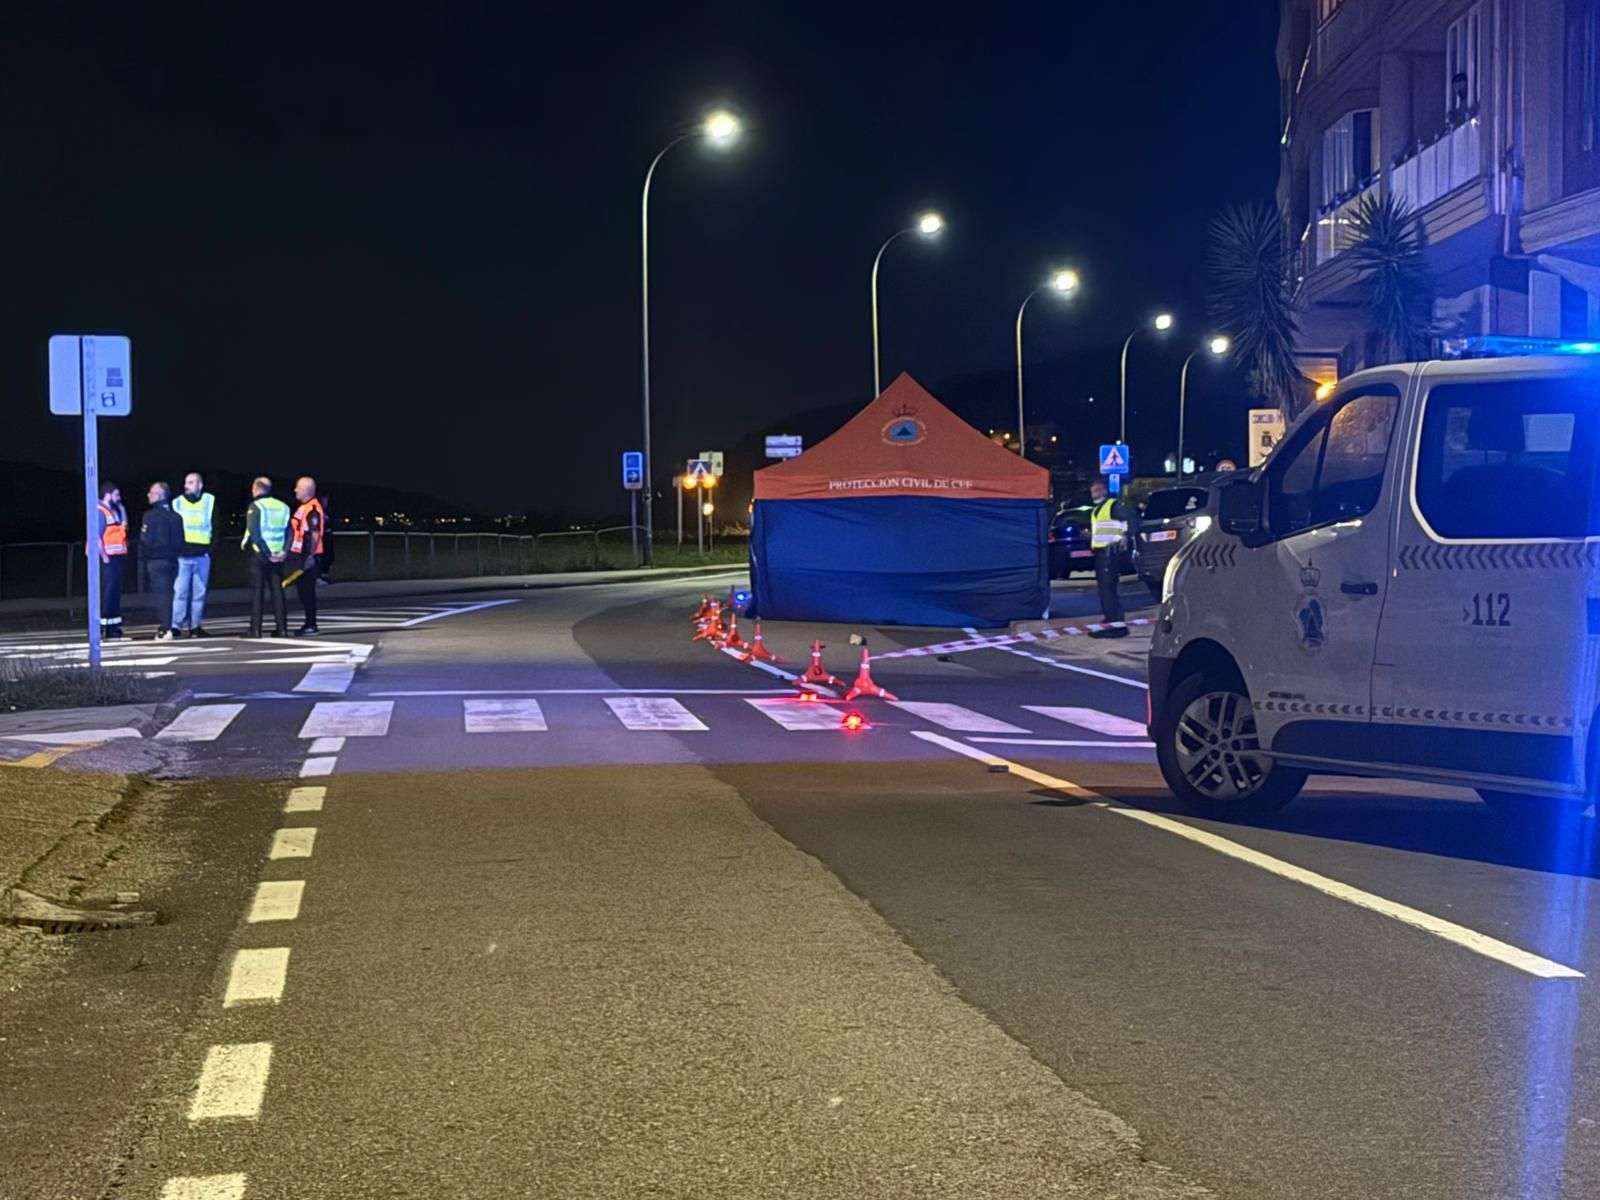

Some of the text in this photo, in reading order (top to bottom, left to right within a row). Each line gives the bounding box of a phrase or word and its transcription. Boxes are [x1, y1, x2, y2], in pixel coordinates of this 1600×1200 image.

[901, 477, 932, 489] CIVIL
[933, 479, 949, 489] DE
[1471, 592, 1512, 627] 112
